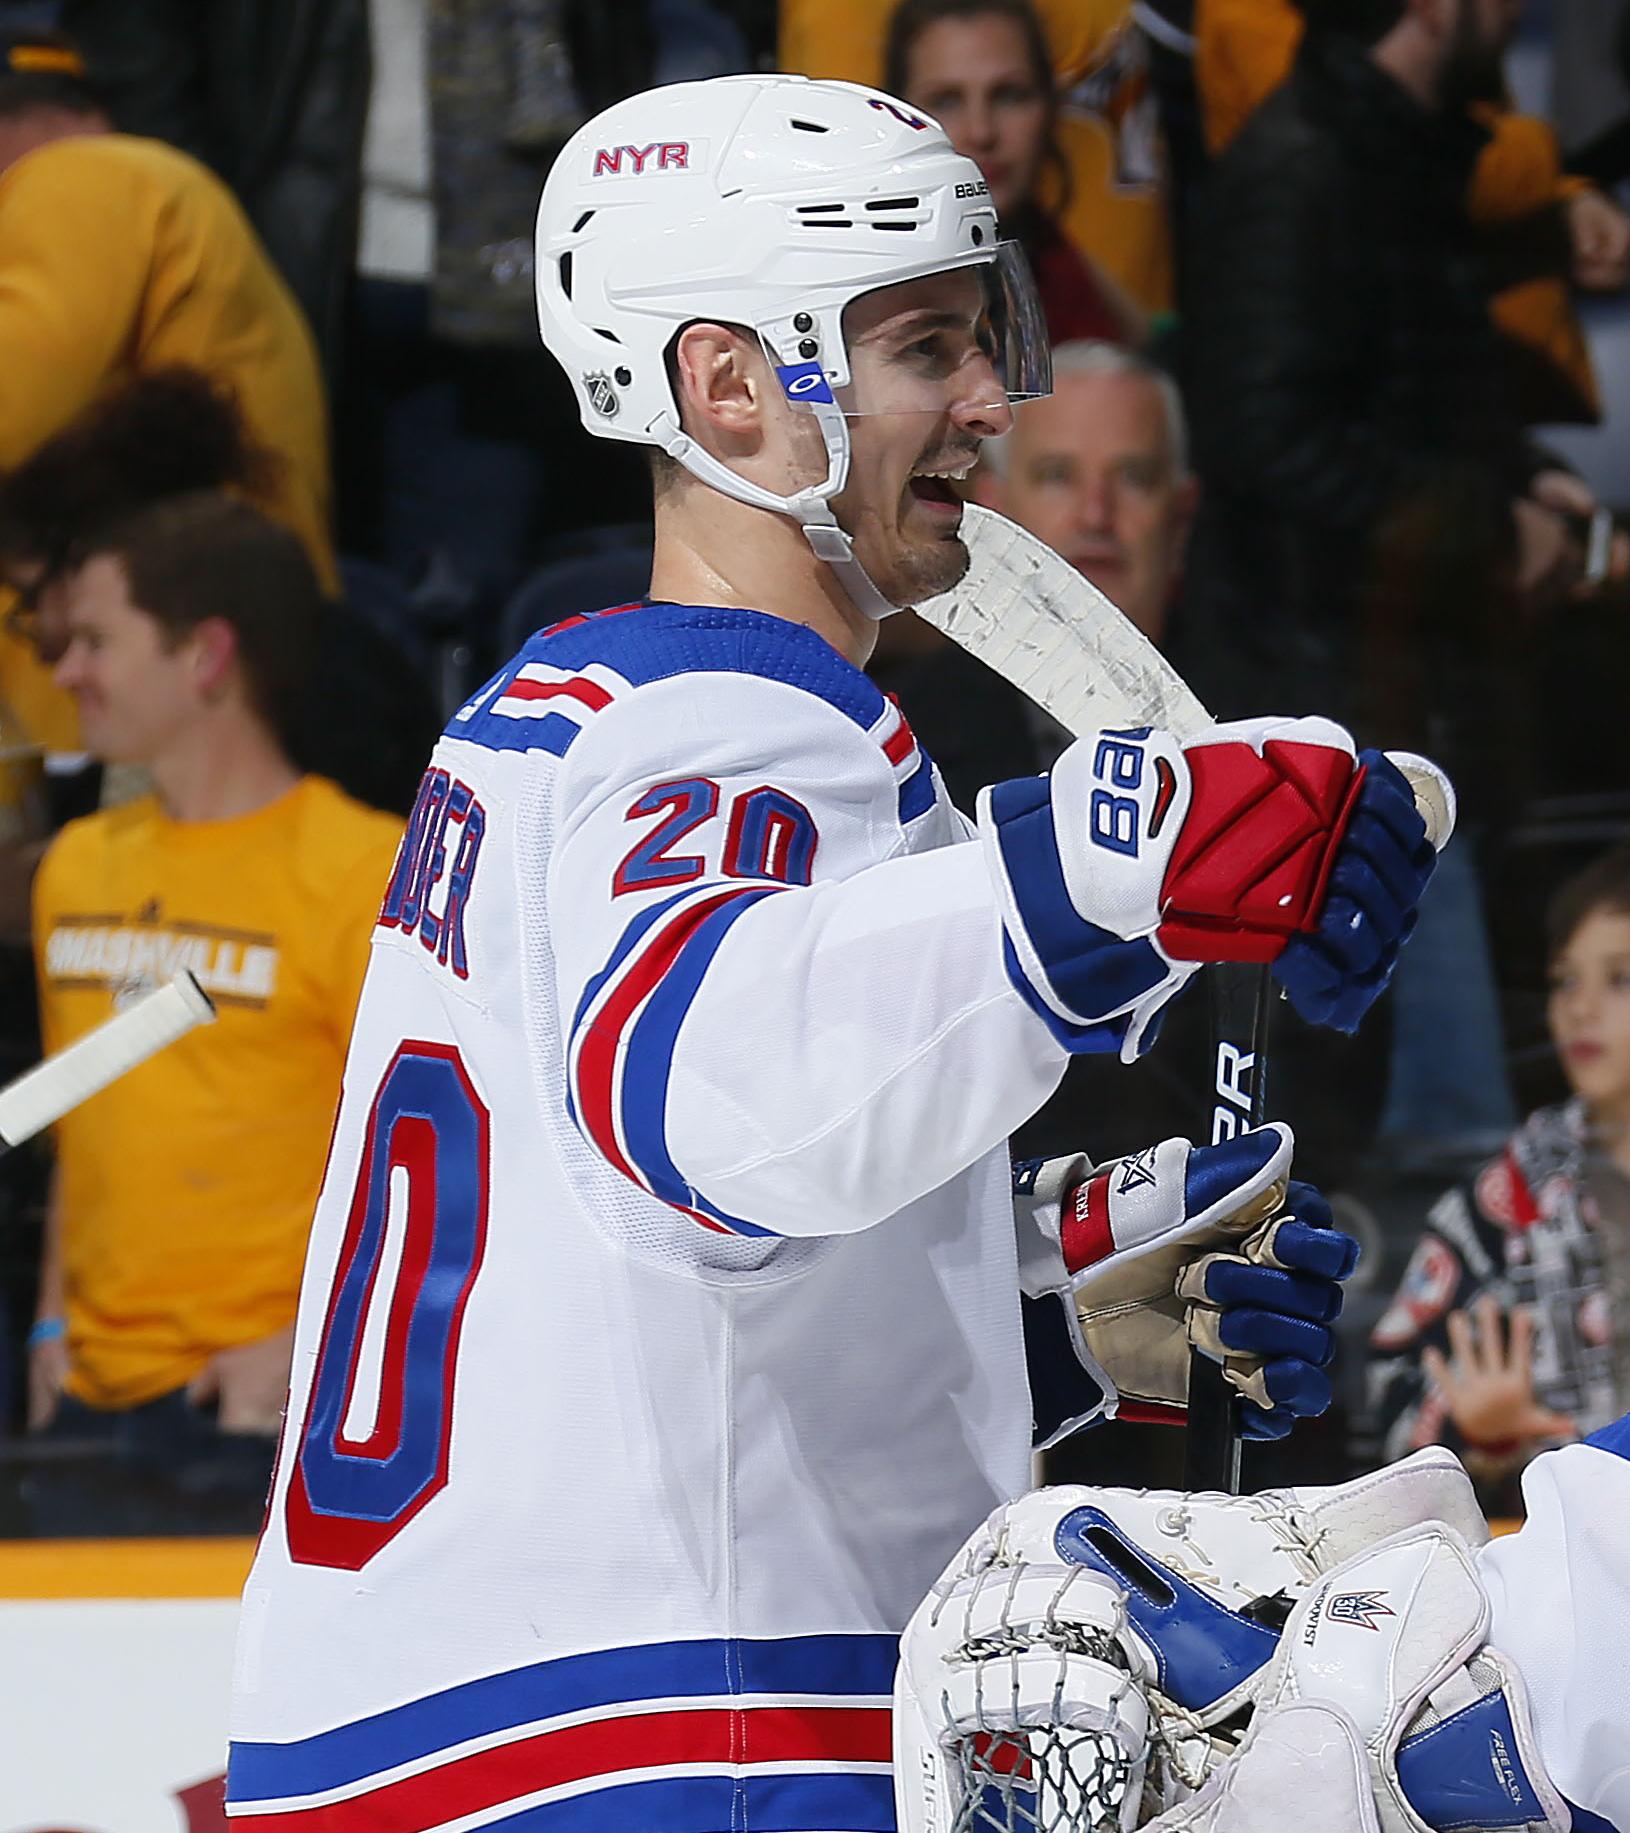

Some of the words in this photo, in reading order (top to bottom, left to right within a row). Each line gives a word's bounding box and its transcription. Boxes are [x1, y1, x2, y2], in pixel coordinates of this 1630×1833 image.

[593, 142, 689, 177] NYR
[286, 1039, 490, 1572] 0
[1490, 1729, 1511, 1767] FREE
[1504, 1769, 1523, 1806] FLEX
